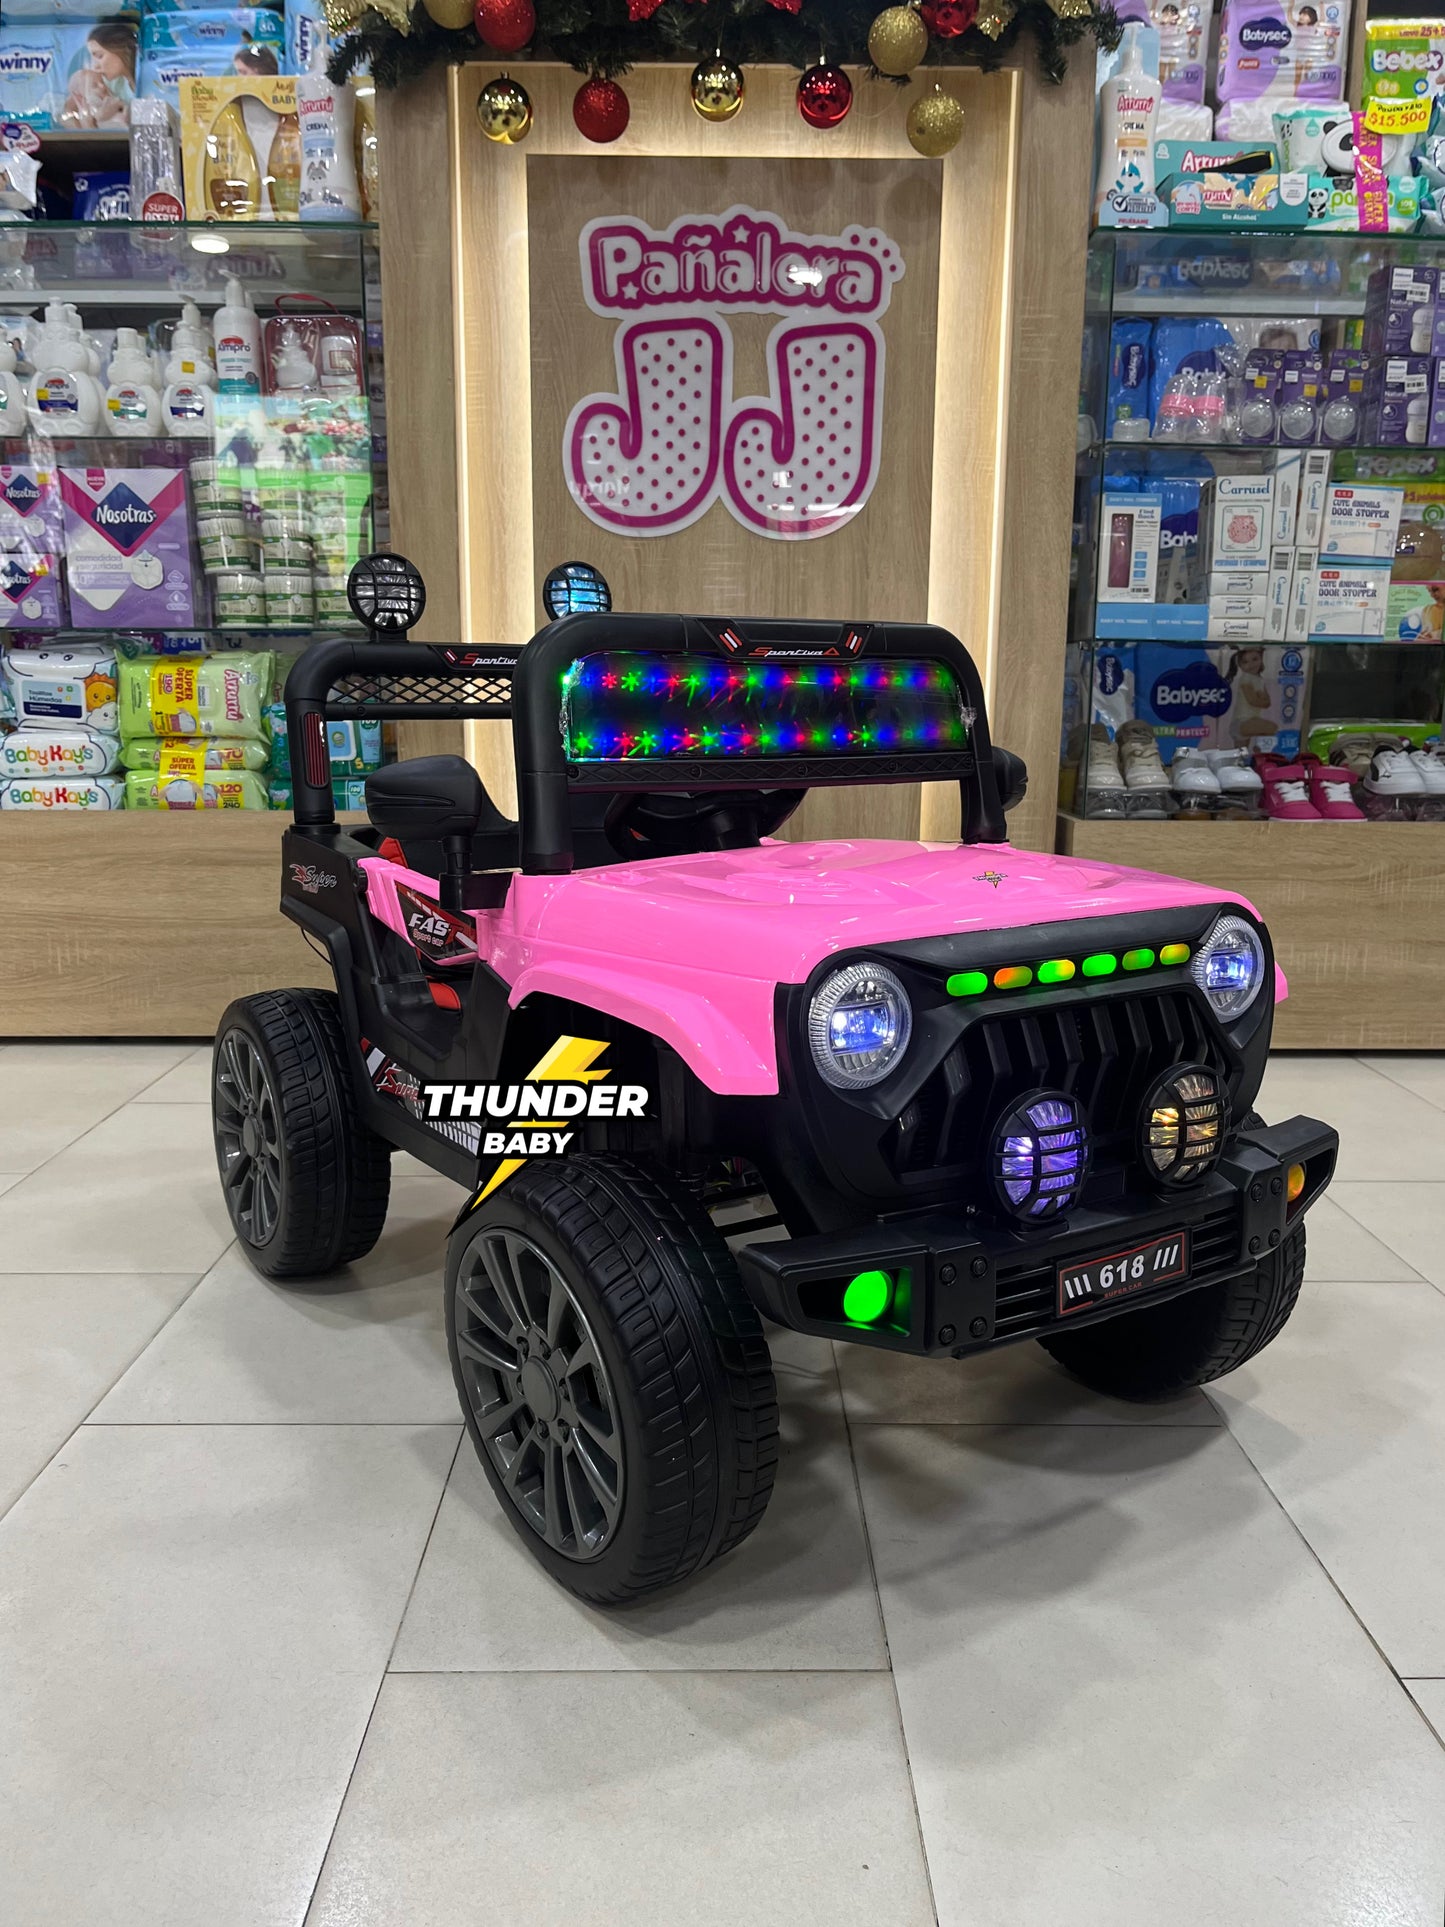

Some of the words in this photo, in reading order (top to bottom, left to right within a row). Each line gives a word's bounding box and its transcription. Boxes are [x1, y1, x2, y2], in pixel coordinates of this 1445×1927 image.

[1242, 28, 1288, 42] Babysec
[0, 52, 50, 72] winny
[1373, 50, 1441, 71] Bebex
[148, 203, 178, 214] SUPER
[598, 229, 876, 305] Pañalera
[570, 315, 878, 533] JJ
[6, 488, 41, 499] Nosotras
[1219, 478, 1270, 494] Carrusel
[96, 504, 156, 524] Nosotras
[1332, 508, 1353, 516] DOOR
[1356, 509, 1390, 518] STOPPER
[1318, 588, 1340, 597] DOOR
[1342, 589, 1377, 598] STOPPER
[176, 668, 184, 702] OFERTA
[1157, 684, 1228, 706] Babysec
[5, 744, 48, 766] Baby
[50, 744, 93, 764] Kay's
[10, 787, 53, 806] Baby
[55, 787, 98, 806] Kay's
[220, 784, 242, 793] 120
[1100, 1254, 1144, 1288] 618
